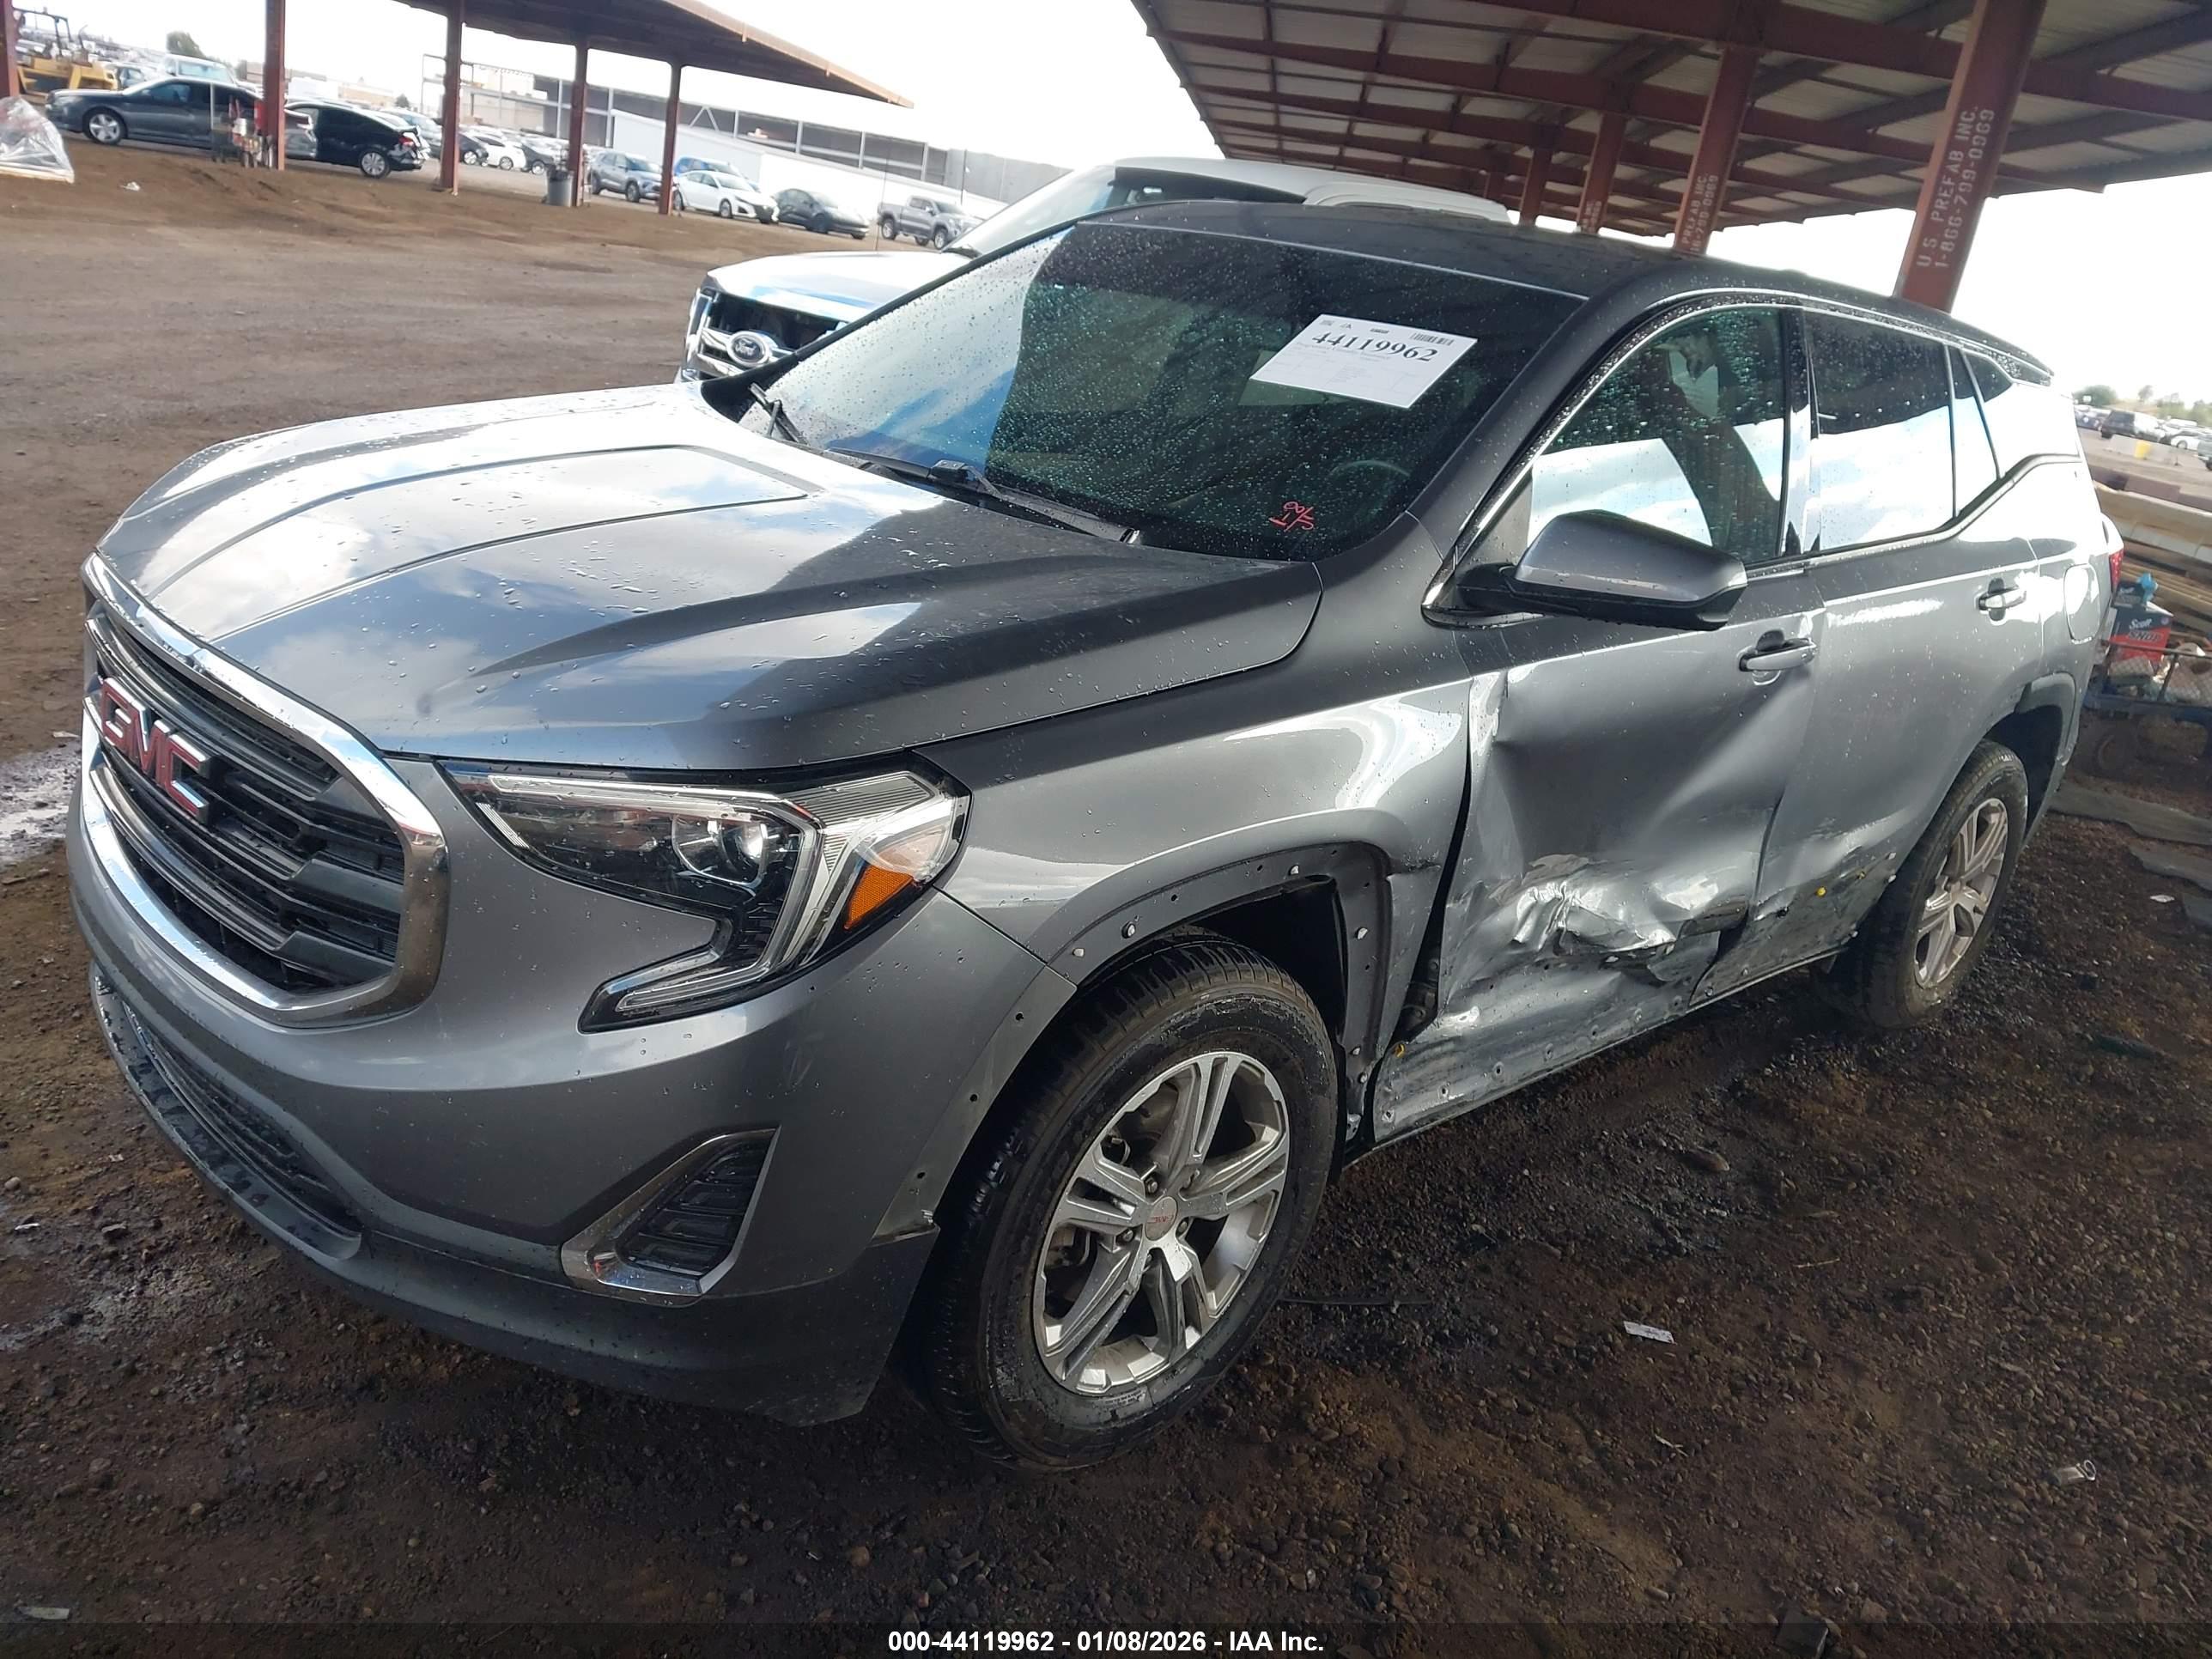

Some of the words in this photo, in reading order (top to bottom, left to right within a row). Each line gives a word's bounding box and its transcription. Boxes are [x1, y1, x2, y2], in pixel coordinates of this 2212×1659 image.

[1930, 149, 1965, 222] PREFAB
[1954, 106, 1978, 142] INC.
[1934, 108, 1996, 268] 1-866-799-0969
[735, 337, 757, 357] Ford
[1311, 331, 1438, 362] 44119962
[100, 678, 212, 825] GMC
